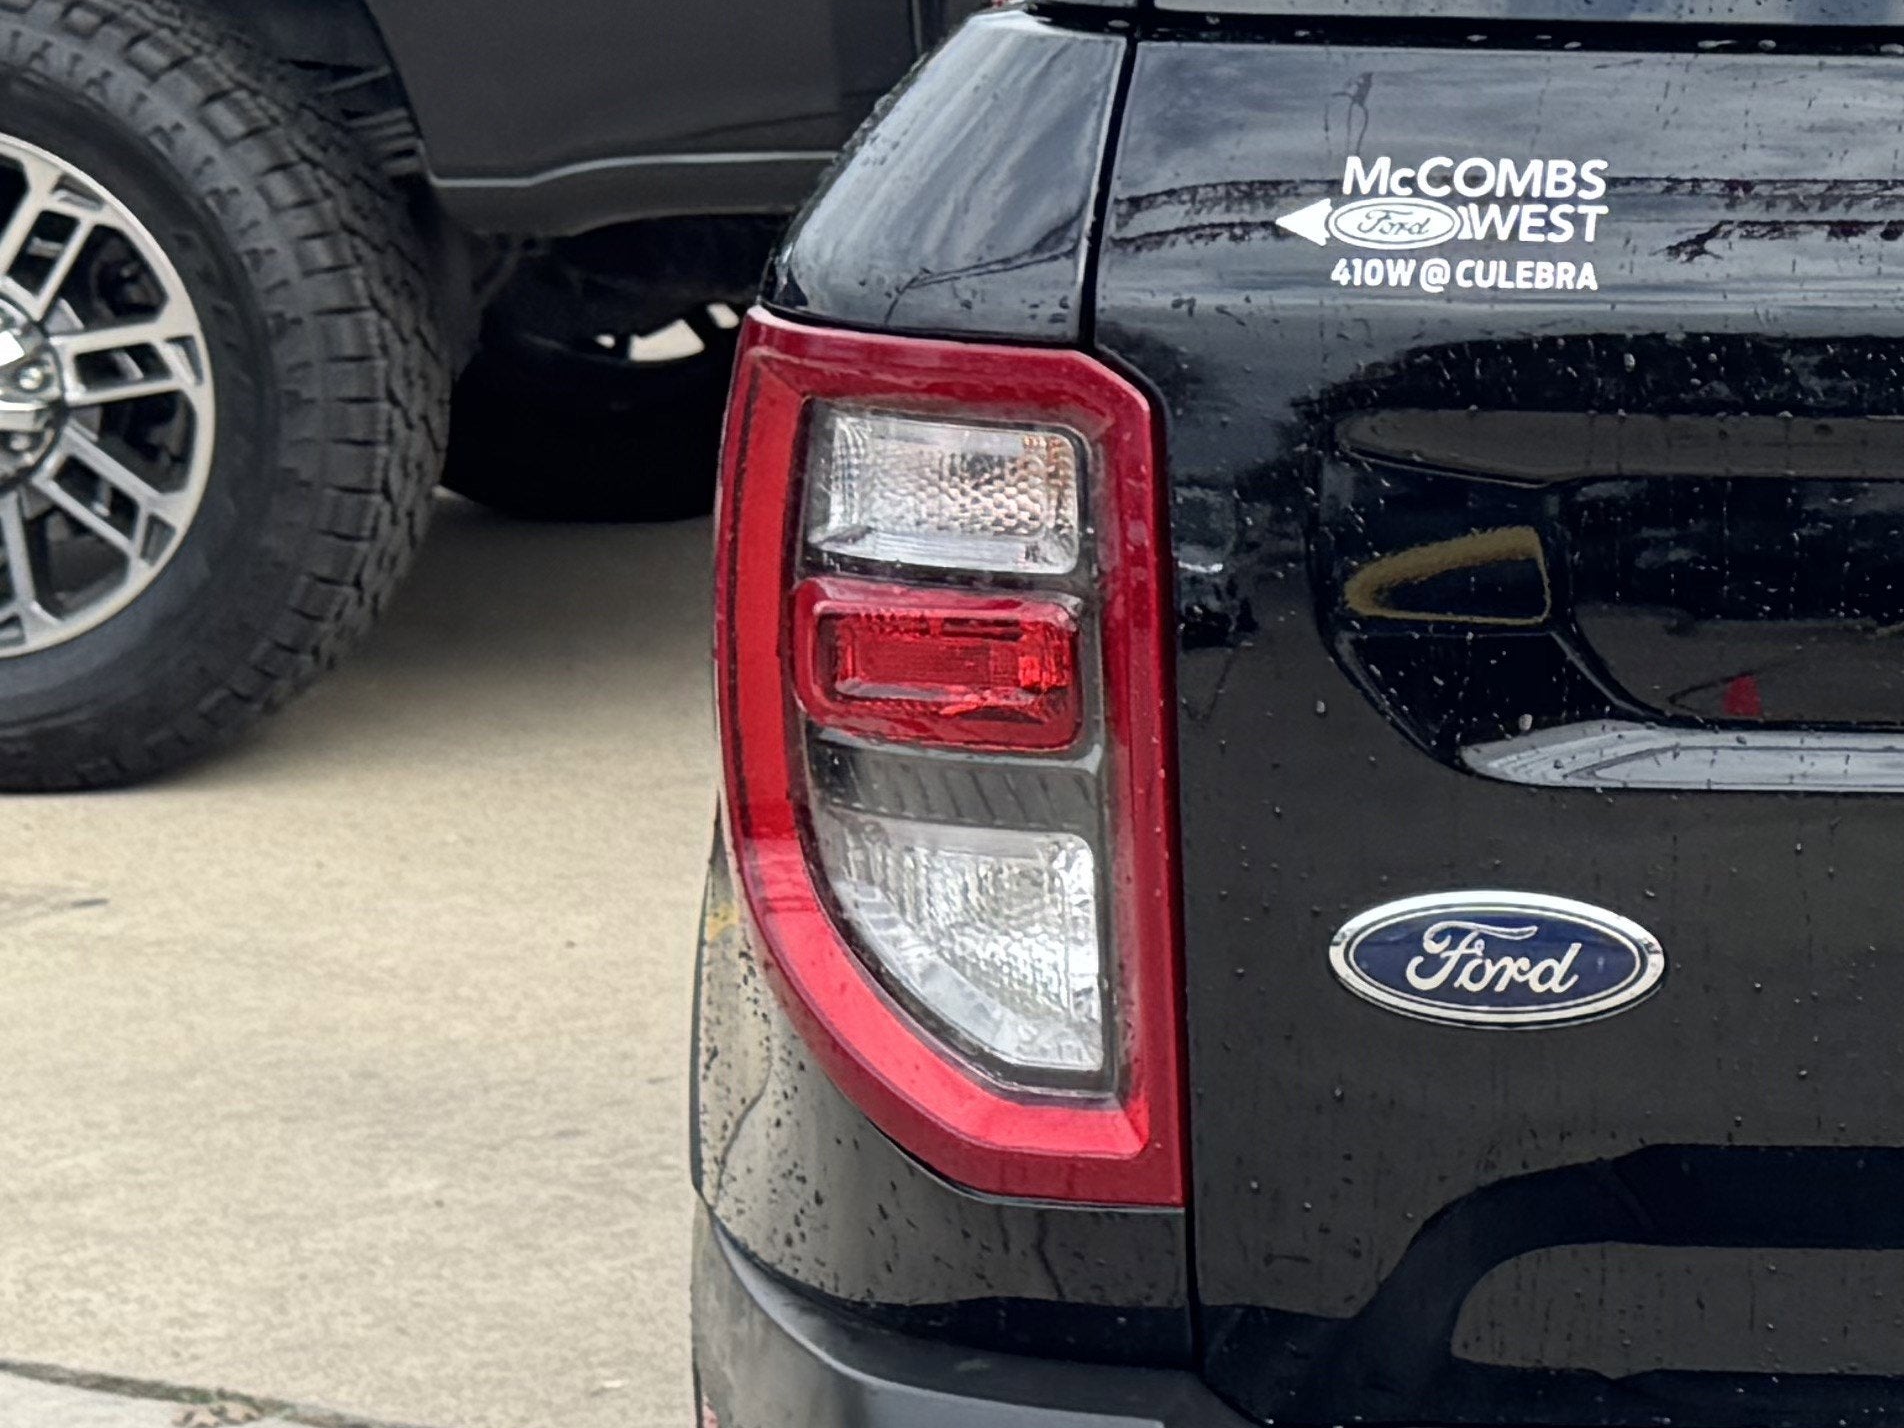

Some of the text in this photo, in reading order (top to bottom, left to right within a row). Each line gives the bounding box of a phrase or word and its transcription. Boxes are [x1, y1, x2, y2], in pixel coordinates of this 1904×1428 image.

[1342, 156, 1609, 200] McCOMBS
[1356, 209, 1431, 240] Ford
[1466, 203, 1609, 243] WEST
[1405, 920, 1583, 994] Ford
